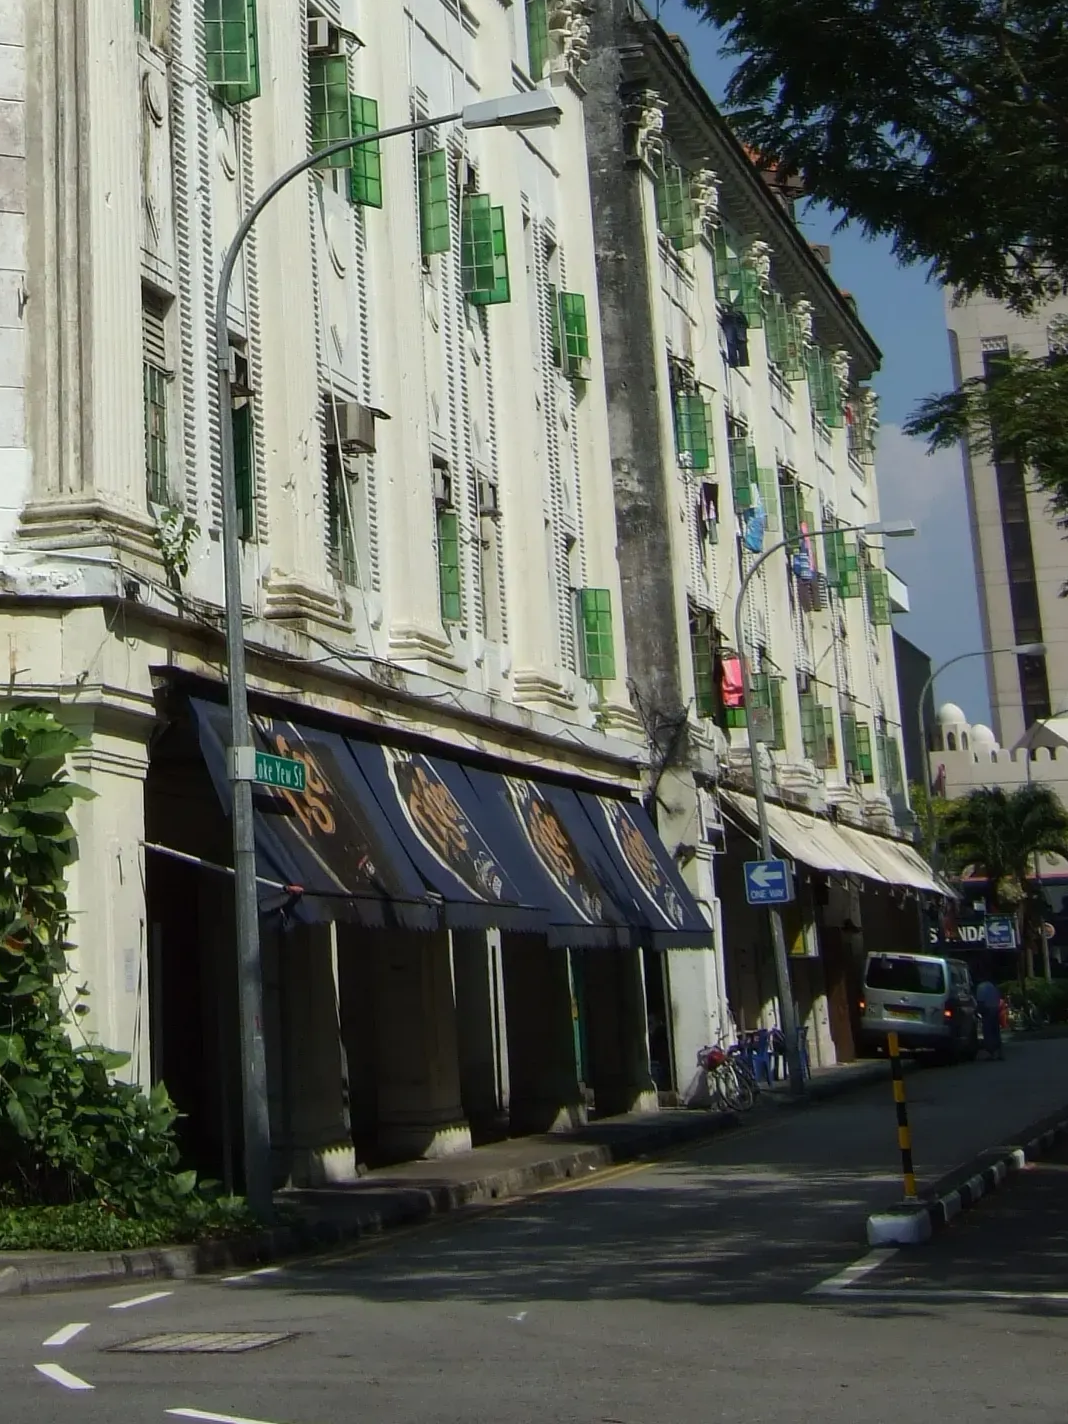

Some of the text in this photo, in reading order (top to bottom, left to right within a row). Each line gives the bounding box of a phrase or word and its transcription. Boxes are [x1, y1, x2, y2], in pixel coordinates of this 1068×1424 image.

[255, 758, 303, 787] oke Yew St
[751, 888, 784, 899] ONE WAY
